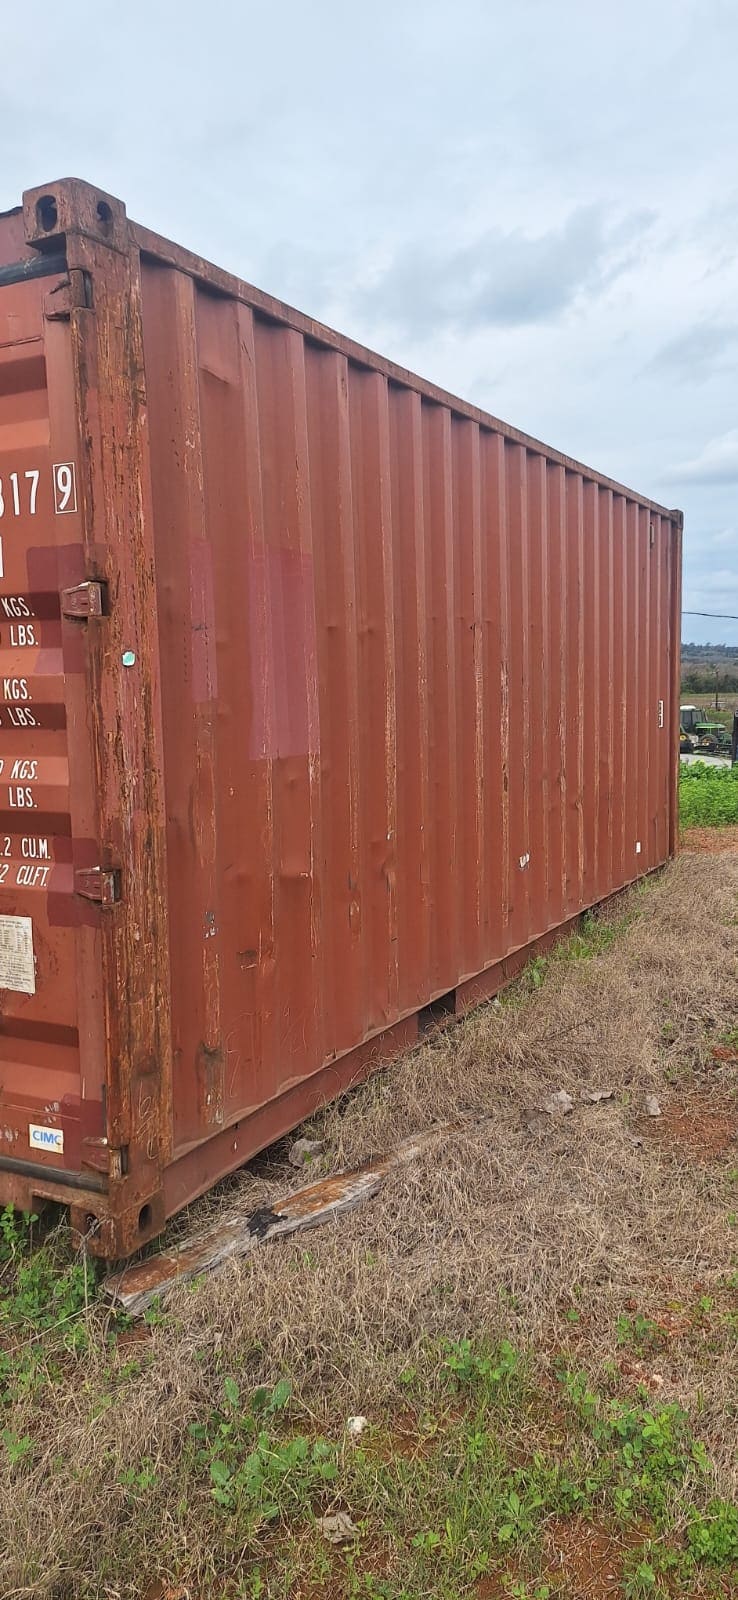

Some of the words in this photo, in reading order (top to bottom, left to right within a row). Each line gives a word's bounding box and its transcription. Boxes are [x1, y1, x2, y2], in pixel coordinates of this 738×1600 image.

[57, 465, 72, 510] 9
[1, 597, 35, 617] KGS.
[10, 625, 38, 646] LBS.
[4, 679, 32, 700] KGS.
[8, 707, 41, 726] LBS.
[11, 760, 38, 779] KGS.
[8, 787, 38, 808] LBS.
[21, 838, 51, 859] CU.M.
[32, 1130, 62, 1145] CIMC
